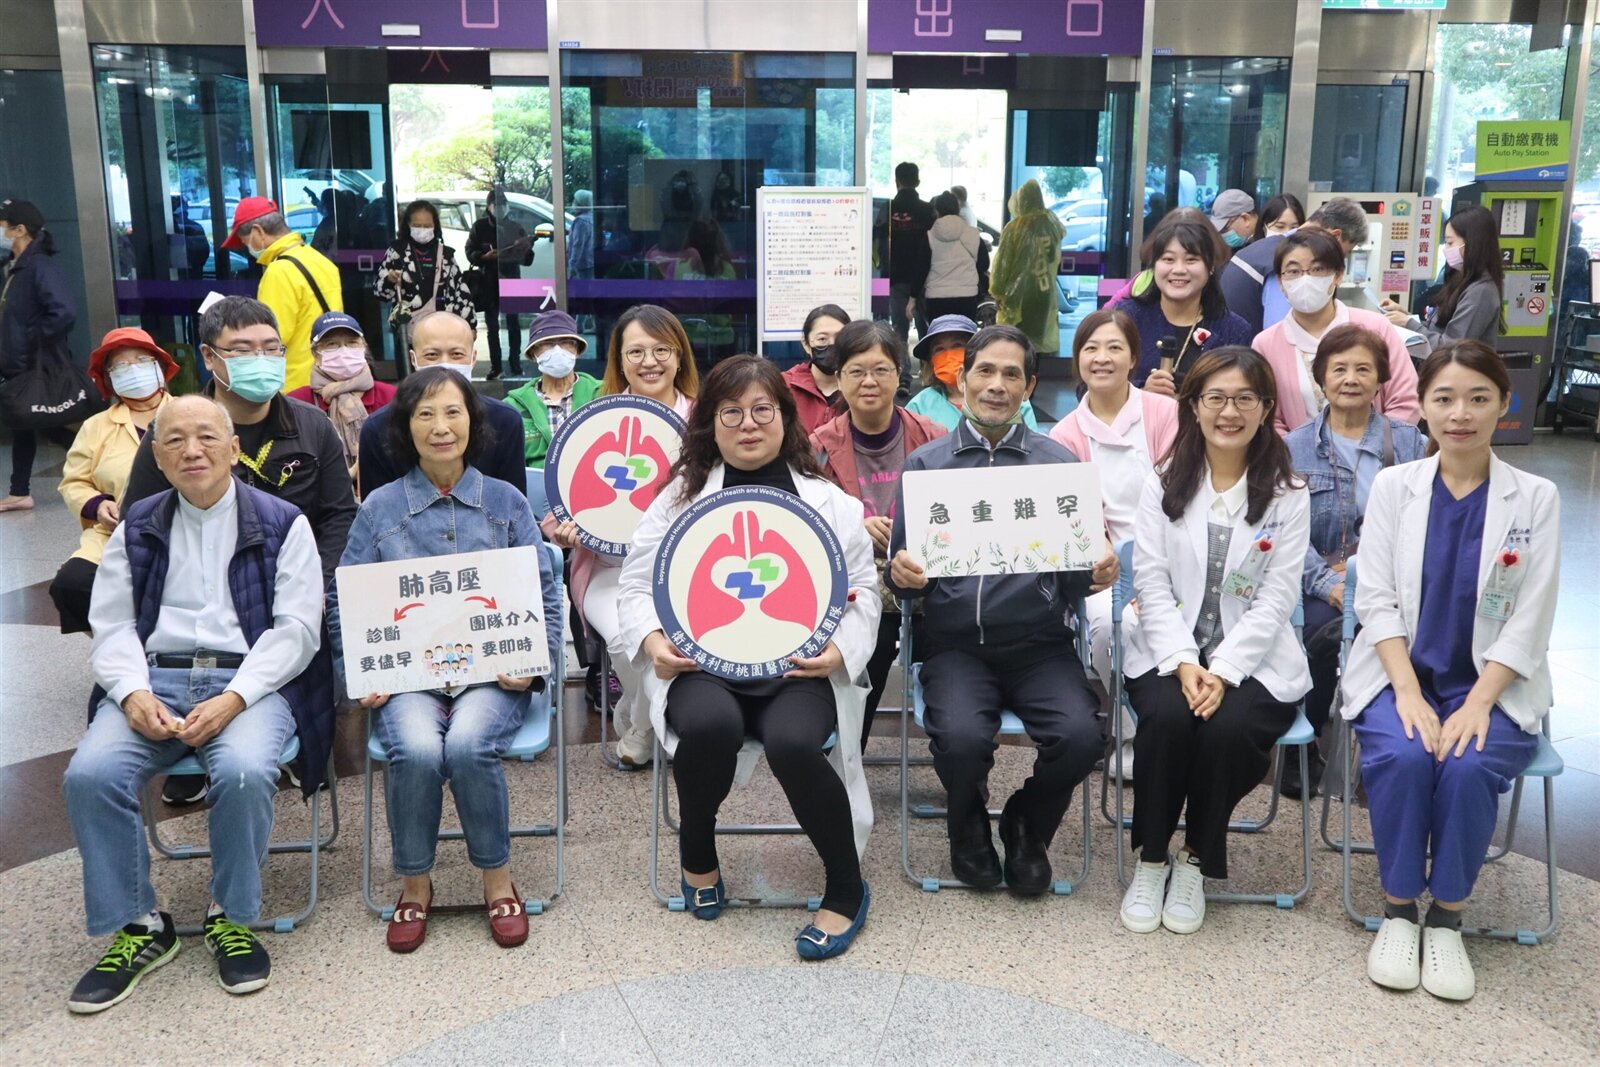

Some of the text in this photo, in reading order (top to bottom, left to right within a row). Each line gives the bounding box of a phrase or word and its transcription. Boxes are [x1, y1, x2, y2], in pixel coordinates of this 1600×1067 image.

[1487, 132, 1559, 147] 自動繳費機
[1512, 149, 1524, 158] Pay
[1538, 217, 1544, 227] 1
[1417, 200, 1432, 267] 口罩販賣機
[1503, 250, 1511, 261] 2
[1534, 354, 1542, 364] 3
[31, 399, 76, 414] KANGOL
[550, 442, 560, 465] Taoyuan
[557, 423, 571, 443] General
[570, 408, 591, 426] Hospital,
[589, 398, 610, 410] Ministry
[929, 494, 1078, 525] 急重難罕
[658, 558, 666, 585] Taoyuan
[662, 534, 675, 558] General
[673, 511, 695, 535] Hospital,
[693, 495, 716, 512] Ministry
[724, 488, 745, 497] Health
[759, 487, 784, 500] Welfare,
[785, 495, 815, 518] Pulmonary
[813, 516, 838, 555] Hypertension
[398, 567, 481, 598] 肺高壓
[469, 609, 539, 632] 團隊介入
[366, 625, 401, 644] 診斷
[482, 636, 533, 658] 要即時
[360, 651, 412, 673] 要儘早
